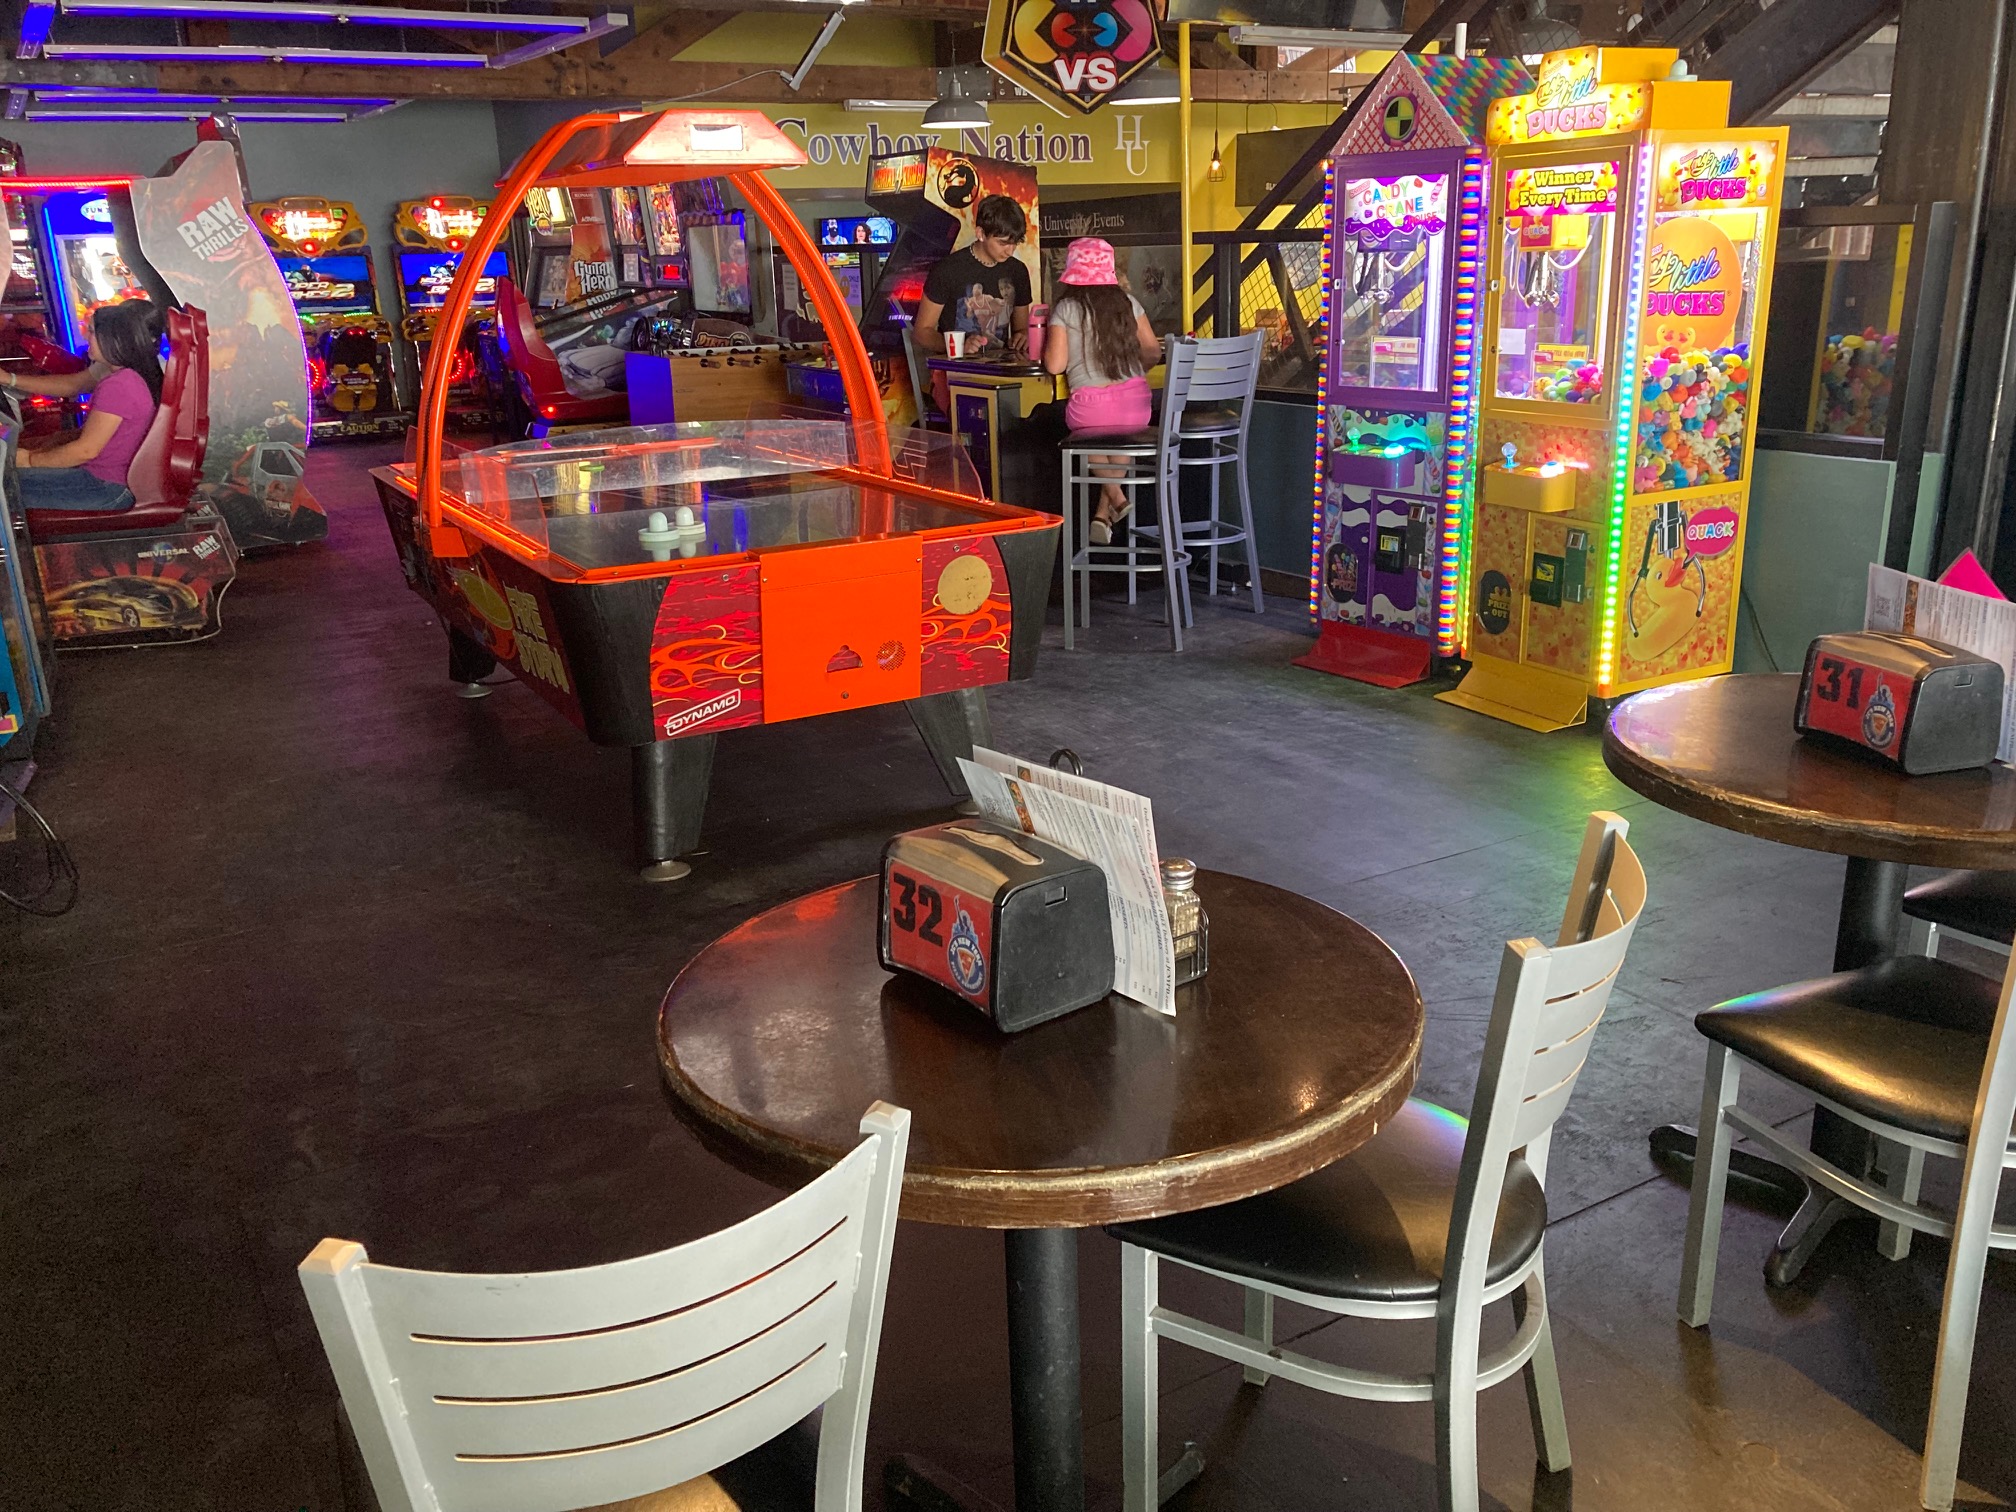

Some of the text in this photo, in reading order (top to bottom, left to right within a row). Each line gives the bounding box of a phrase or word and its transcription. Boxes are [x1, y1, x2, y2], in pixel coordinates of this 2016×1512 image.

[1053, 57, 1117, 92] VS
[1526, 101, 1608, 139] DUCKS
[960, 118, 1094, 164] Nation
[1534, 169, 1594, 188] Winner
[1681, 176, 1747, 204] DUCKS
[1363, 181, 1410, 205] CANDY
[1519, 187, 1608, 209] Every Time
[1376, 197, 1424, 219] CRANE
[1409, 211, 1437, 224] HOUSE
[176, 196, 238, 248] RAW
[1043, 213, 1090, 232] University
[1093, 212, 1125, 228] Events
[1523, 224, 1550, 237] QUACK
[192, 218, 249, 260] THRILLS
[1669, 247, 1722, 292] little
[1686, 520, 1735, 541] QUACK
[137, 547, 190, 559] UNIVERSAL
[192, 535, 219, 556] RAW
[1491, 609, 1509, 619] OUT
[1817, 657, 1865, 711] 31
[664, 695, 736, 730] DYNAMO
[893, 871, 943, 948] 32
[957, 937, 971, 947] NEW
